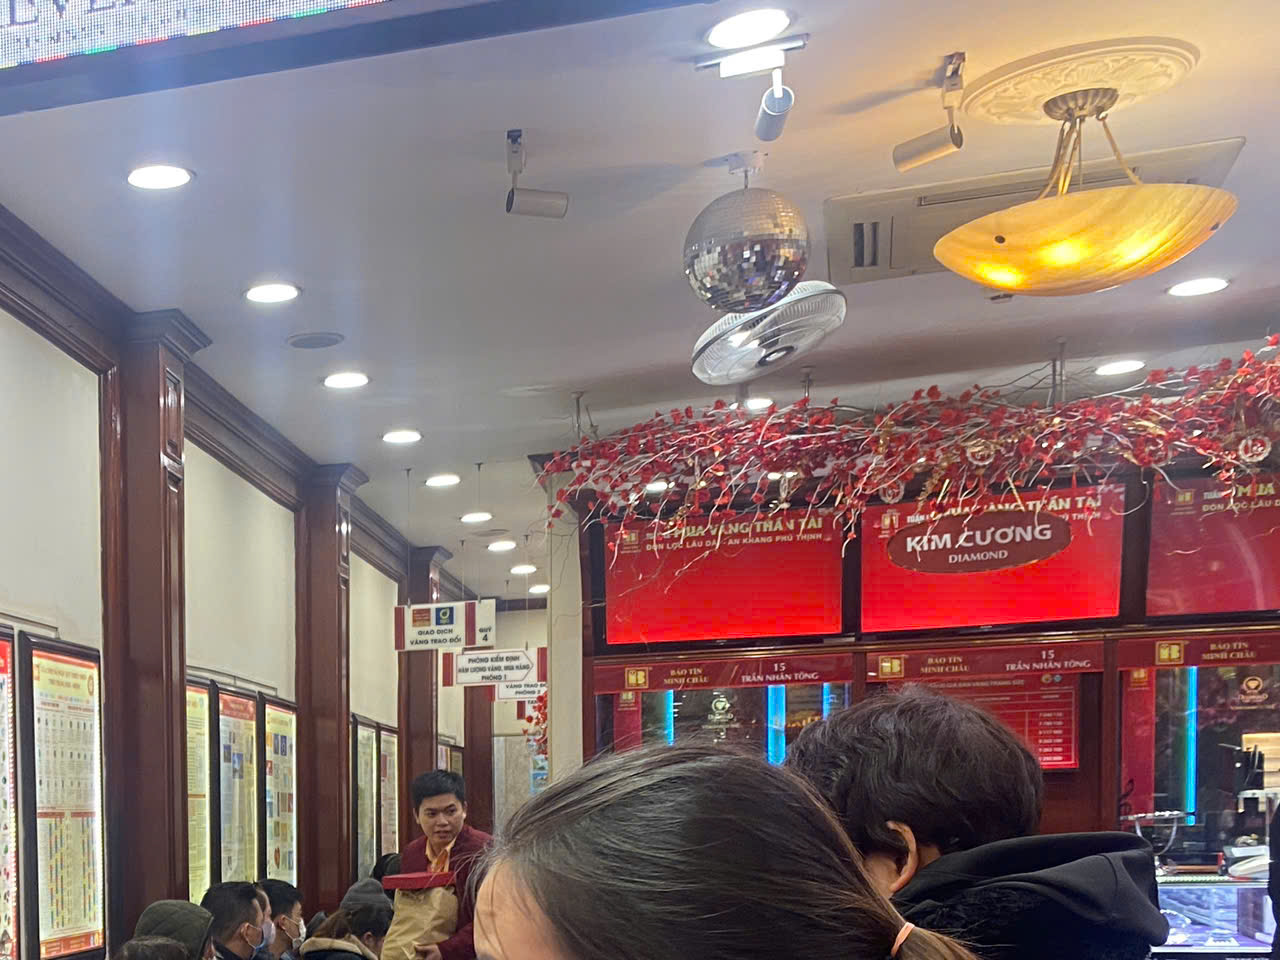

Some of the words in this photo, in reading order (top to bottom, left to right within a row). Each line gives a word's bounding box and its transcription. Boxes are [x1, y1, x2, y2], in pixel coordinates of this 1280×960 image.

[906, 533, 952, 553] KIM
[958, 524, 1052, 547] CƯƠNG
[948, 550, 1008, 564] DIAMOND
[449, 635, 461, 643] ĐỔI
[1041, 649, 1055, 659] 15
[773, 662, 786, 672] 15
